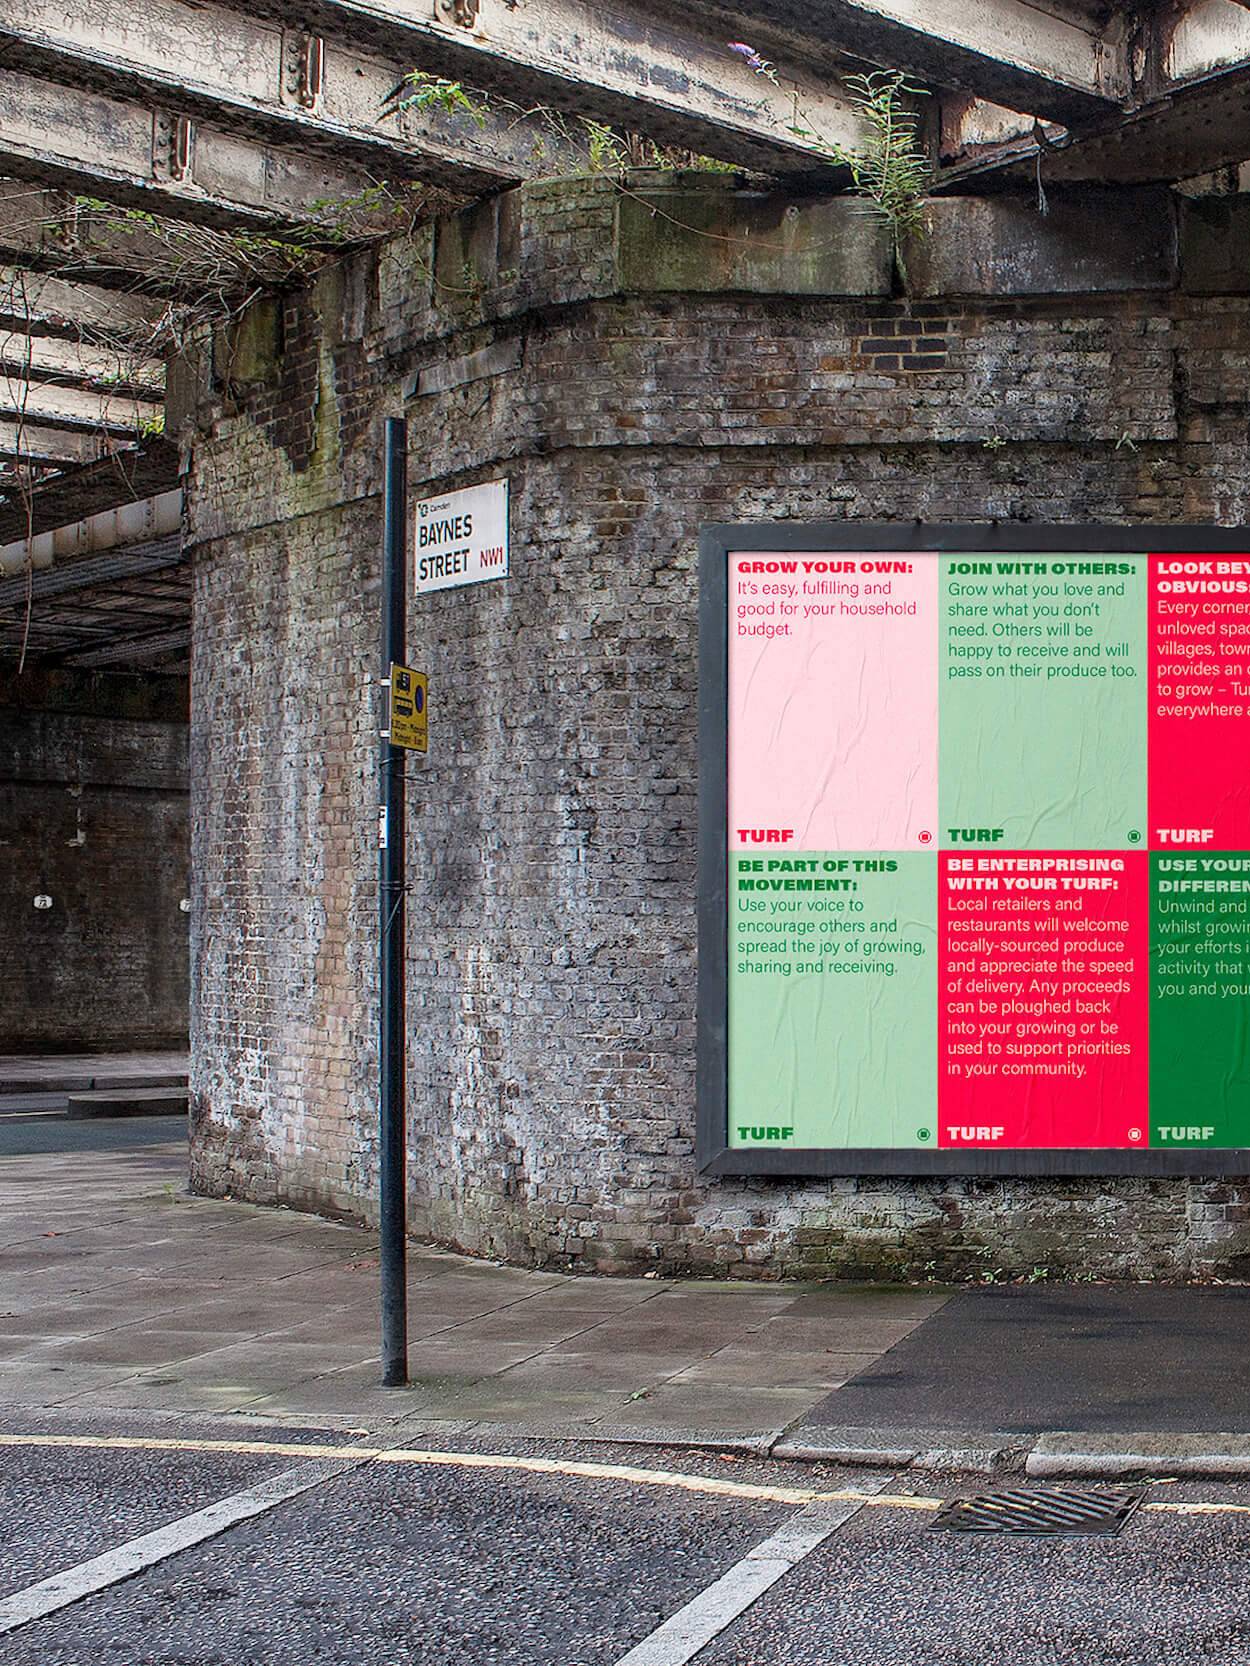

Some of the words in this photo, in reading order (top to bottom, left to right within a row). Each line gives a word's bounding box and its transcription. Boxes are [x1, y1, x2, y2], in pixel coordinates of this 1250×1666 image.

[419, 514, 472, 547] BAYNES
[419, 548, 470, 580] STREET
[480, 546, 503, 568] NW1
[738, 561, 798, 573] GROW
[802, 562, 856, 573] YOUR
[860, 561, 912, 573] OWN:
[948, 563, 992, 575] JOIN
[997, 563, 1047, 575] WITH
[1052, 563, 1135, 576] OTHERS:
[1158, 562, 1213, 574] LOOK
[739, 581, 758, 595] It's
[763, 584, 798, 598] easy,
[803, 581, 858, 598] fulfilling
[864, 581, 891, 594] and
[949, 582, 988, 596] Grow
[993, 582, 1027, 596] what
[1033, 585, 1058, 599] you
[1064, 582, 1092, 597] love
[1097, 582, 1124, 596] and
[738, 601, 774, 618] good
[780, 601, 798, 615] for
[804, 605, 835, 618] your
[841, 601, 916, 615] household
[948, 602, 987, 616] share
[993, 602, 1028, 616] what
[1033, 606, 1059, 619] you
[1064, 602, 1099, 616] don't
[1158, 600, 1199, 618] Every
[738, 622, 792, 638] budget.
[1158, 620, 1215, 635] unloved
[1157, 641, 1215, 658] villages,
[737, 829, 793, 843] TURF
[948, 829, 1004, 842] TURF
[1156, 829, 1214, 843] TURF
[738, 860, 763, 872] BE
[768, 860, 819, 872] PART
[823, 860, 848, 872] OF
[852, 860, 897, 872] THIS
[948, 859, 973, 871] BE
[978, 859, 1124, 871] ENTERPRISING
[1159, 860, 1197, 871] USE
[739, 879, 857, 891] MOVEMENT:
[947, 878, 998, 890] WITH
[1003, 878, 1057, 890] YOUR
[1061, 878, 1118, 890] TURF:
[739, 898, 766, 911] Use
[770, 901, 802, 915] your
[807, 901, 844, 913] voice
[849, 899, 863, 911] to
[948, 896, 987, 911] Local
[992, 896, 1050, 911] retailers
[1055, 896, 1082, 911] and
[1159, 899, 1214, 913] Unwind
[1220, 900, 1246, 913] and
[738, 922, 815, 936] encourage
[819, 919, 865, 933] others
[870, 918, 897, 933] and
[948, 919, 1030, 931] restaurants
[1034, 917, 1058, 932] will
[1063, 917, 1129, 932] welcome
[1158, 920, 1200, 933] whilst
[738, 939, 786, 956] spread
[792, 939, 815, 952] the
[818, 939, 840, 956] joy
[845, 939, 859, 952] of
[863, 939, 925, 956] growing,
[948, 938, 1058, 956] locally-sourced
[1064, 938, 1124, 955] produce
[1158, 944, 1190, 957] your
[1195, 940, 1241, 954] efforts
[738, 960, 791, 976] sharing
[796, 960, 823, 974] and
[829, 960, 897, 976] receiving.
[737, 1127, 793, 1140] TURF
[947, 1127, 1004, 1140] TURF
[1158, 1127, 1214, 1140] TURF
